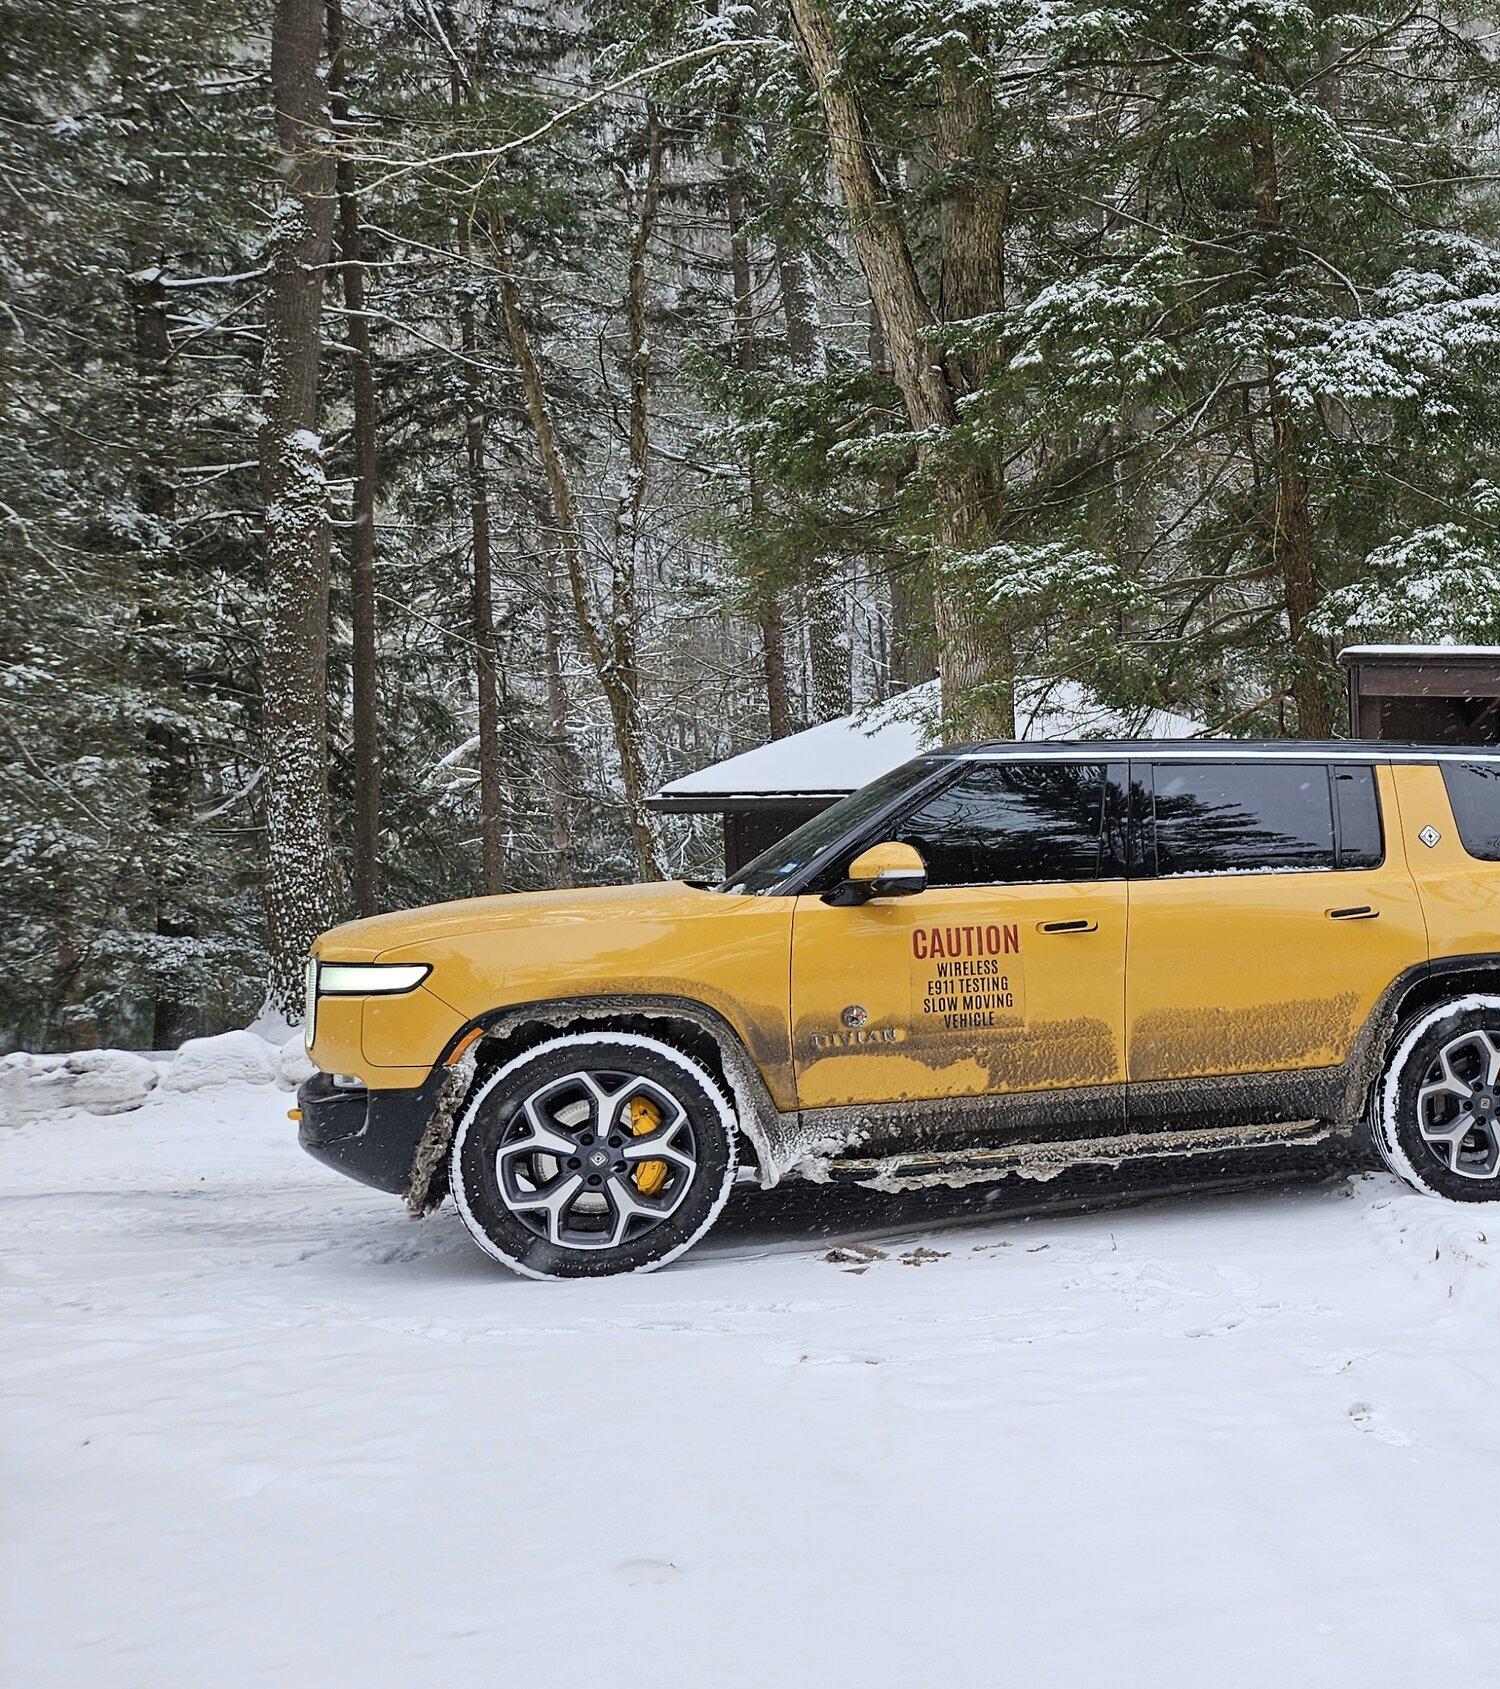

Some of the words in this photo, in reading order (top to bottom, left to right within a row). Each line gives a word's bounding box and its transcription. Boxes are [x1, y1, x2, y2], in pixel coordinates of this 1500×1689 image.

[912, 924, 1020, 960] CAUTION
[937, 959, 999, 978] WIRELESS
[927, 979, 955, 996] E911
[959, 976, 1009, 994] TESTING
[923, 996, 958, 1014] SLOW
[962, 993, 1014, 1011] MOVING
[943, 1011, 995, 1030] VEHICLE
